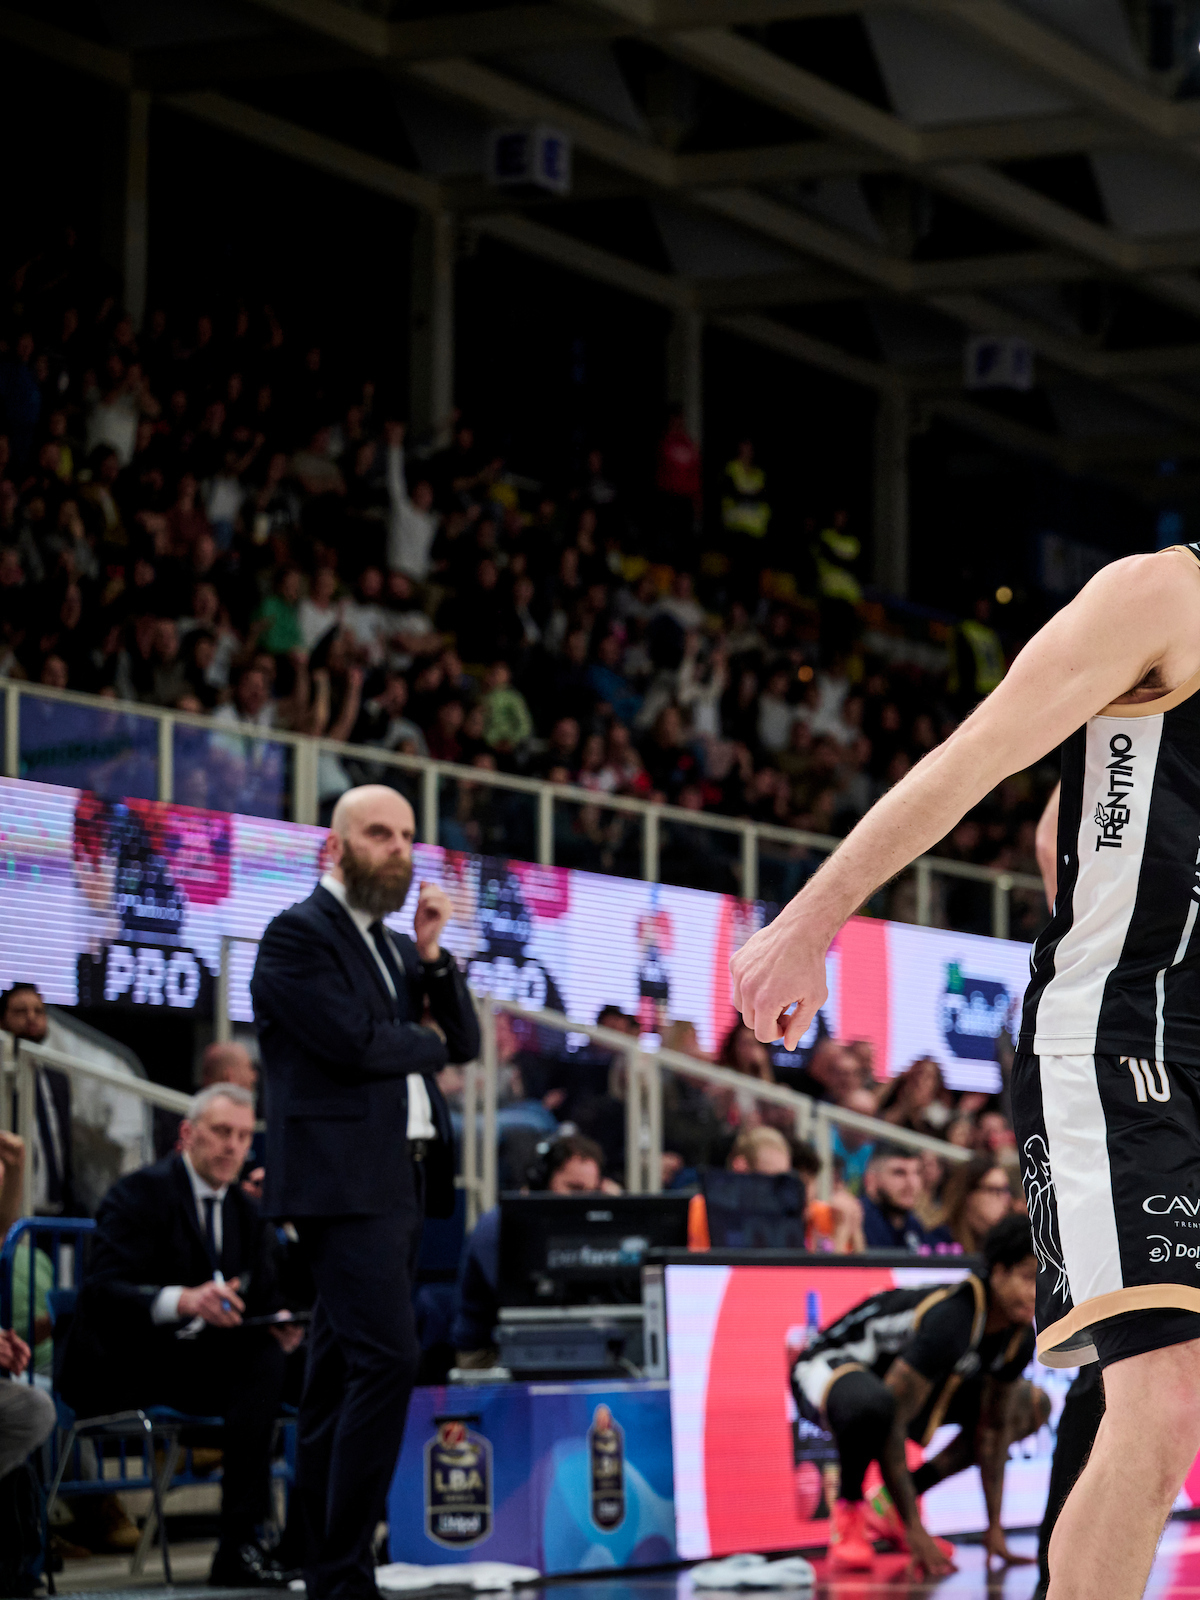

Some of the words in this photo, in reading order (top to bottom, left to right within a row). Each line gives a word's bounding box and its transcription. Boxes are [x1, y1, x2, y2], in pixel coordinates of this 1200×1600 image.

[1095, 733, 1137, 852] TRENTINO
[103, 944, 201, 1009] PRO
[1119, 1055, 1172, 1103] 10
[433, 1468, 483, 1493] LBA
